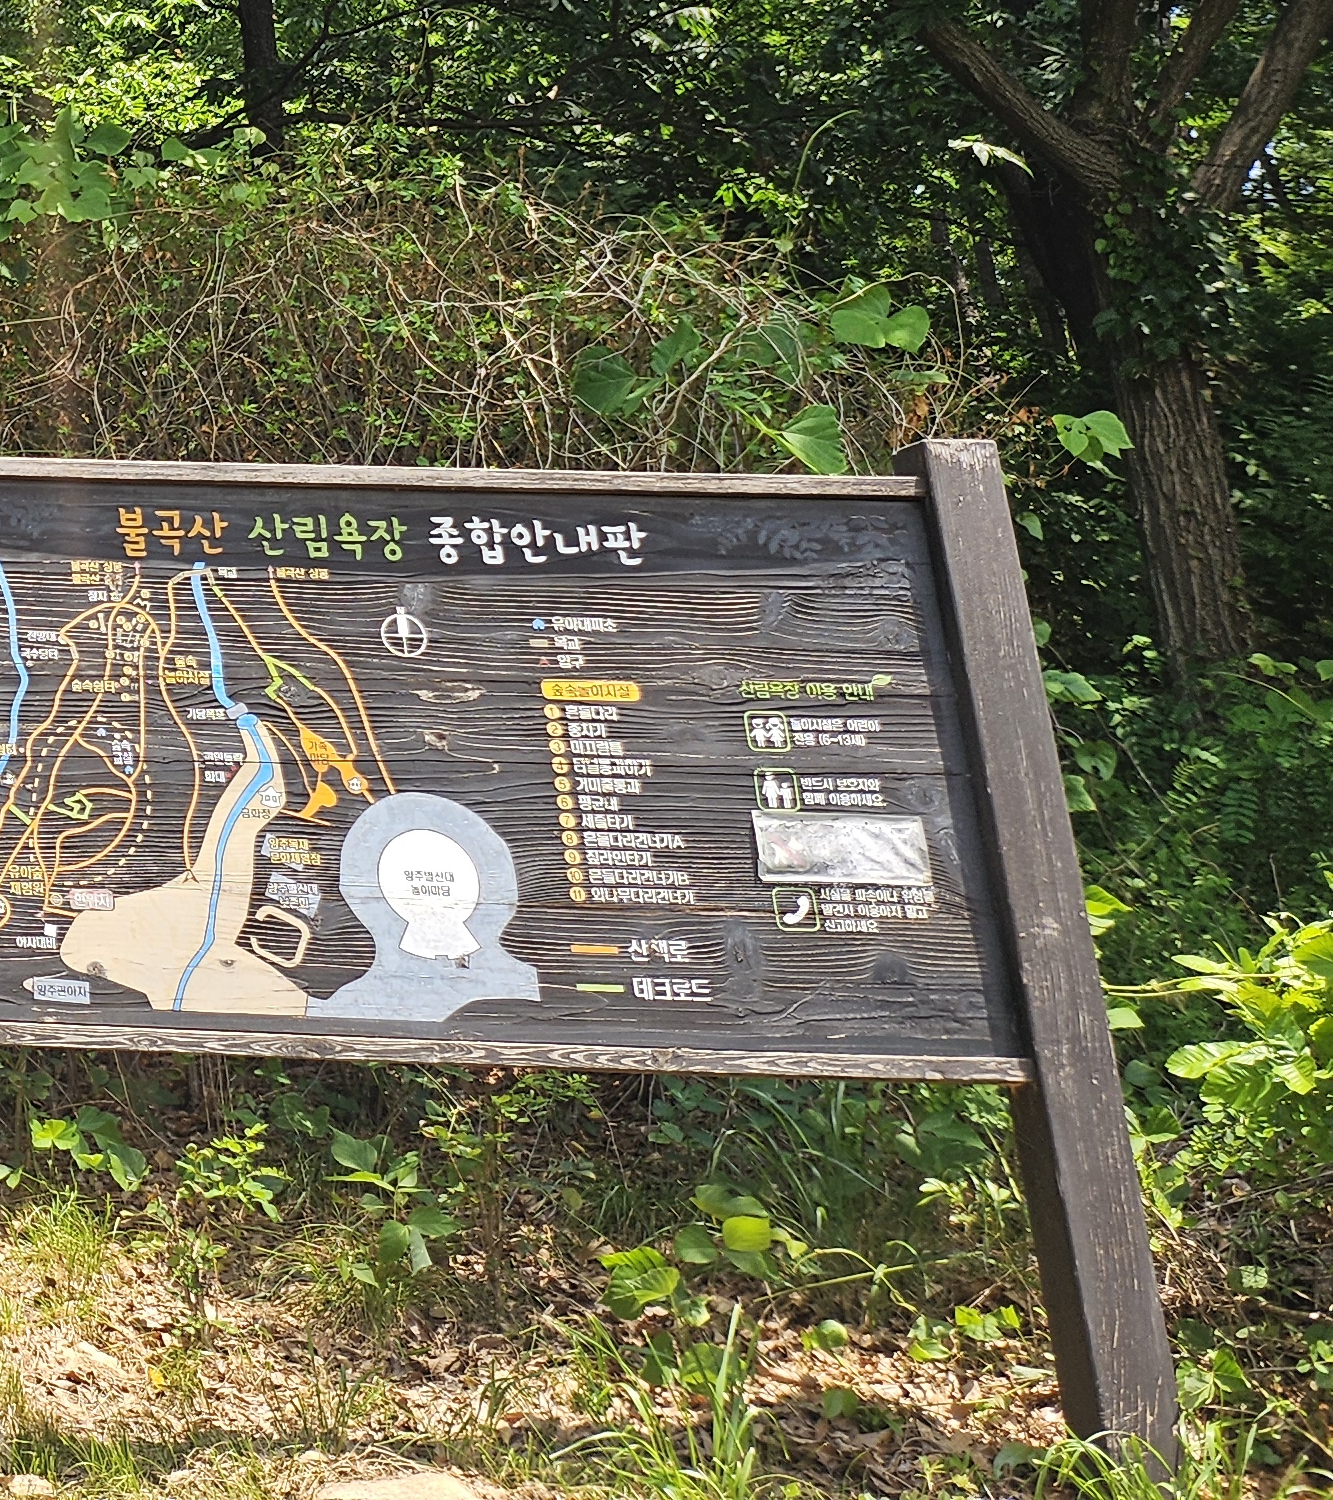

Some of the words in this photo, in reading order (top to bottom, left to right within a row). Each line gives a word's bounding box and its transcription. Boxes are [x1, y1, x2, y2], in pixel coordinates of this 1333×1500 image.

[116, 507, 229, 557] 불곡산
[248, 510, 408, 562] 산림욕장
[428, 514, 649, 566] 종합안내판
[551, 616, 617, 632] 유아대피소
[556, 654, 584, 669] 입구
[71, 680, 116, 694] 숲속쉼터
[551, 684, 630, 698] 숲속놀이시설
[738, 680, 800, 699] 산림욕장
[806, 682, 838, 700] 이용
[842, 683, 875, 701] 안내
[565, 704, 618, 721] 흔들다리
[846, 718, 881, 733] 어린이
[8, 864, 43, 879] 유아숲
[404, 871, 455, 882] 양주별산대
[411, 885, 451, 897] 놀이마당
[628, 939, 690, 963] 산책로
[37, 984, 87, 997] 양주관아지
[633, 977, 713, 1001] 데크로드
